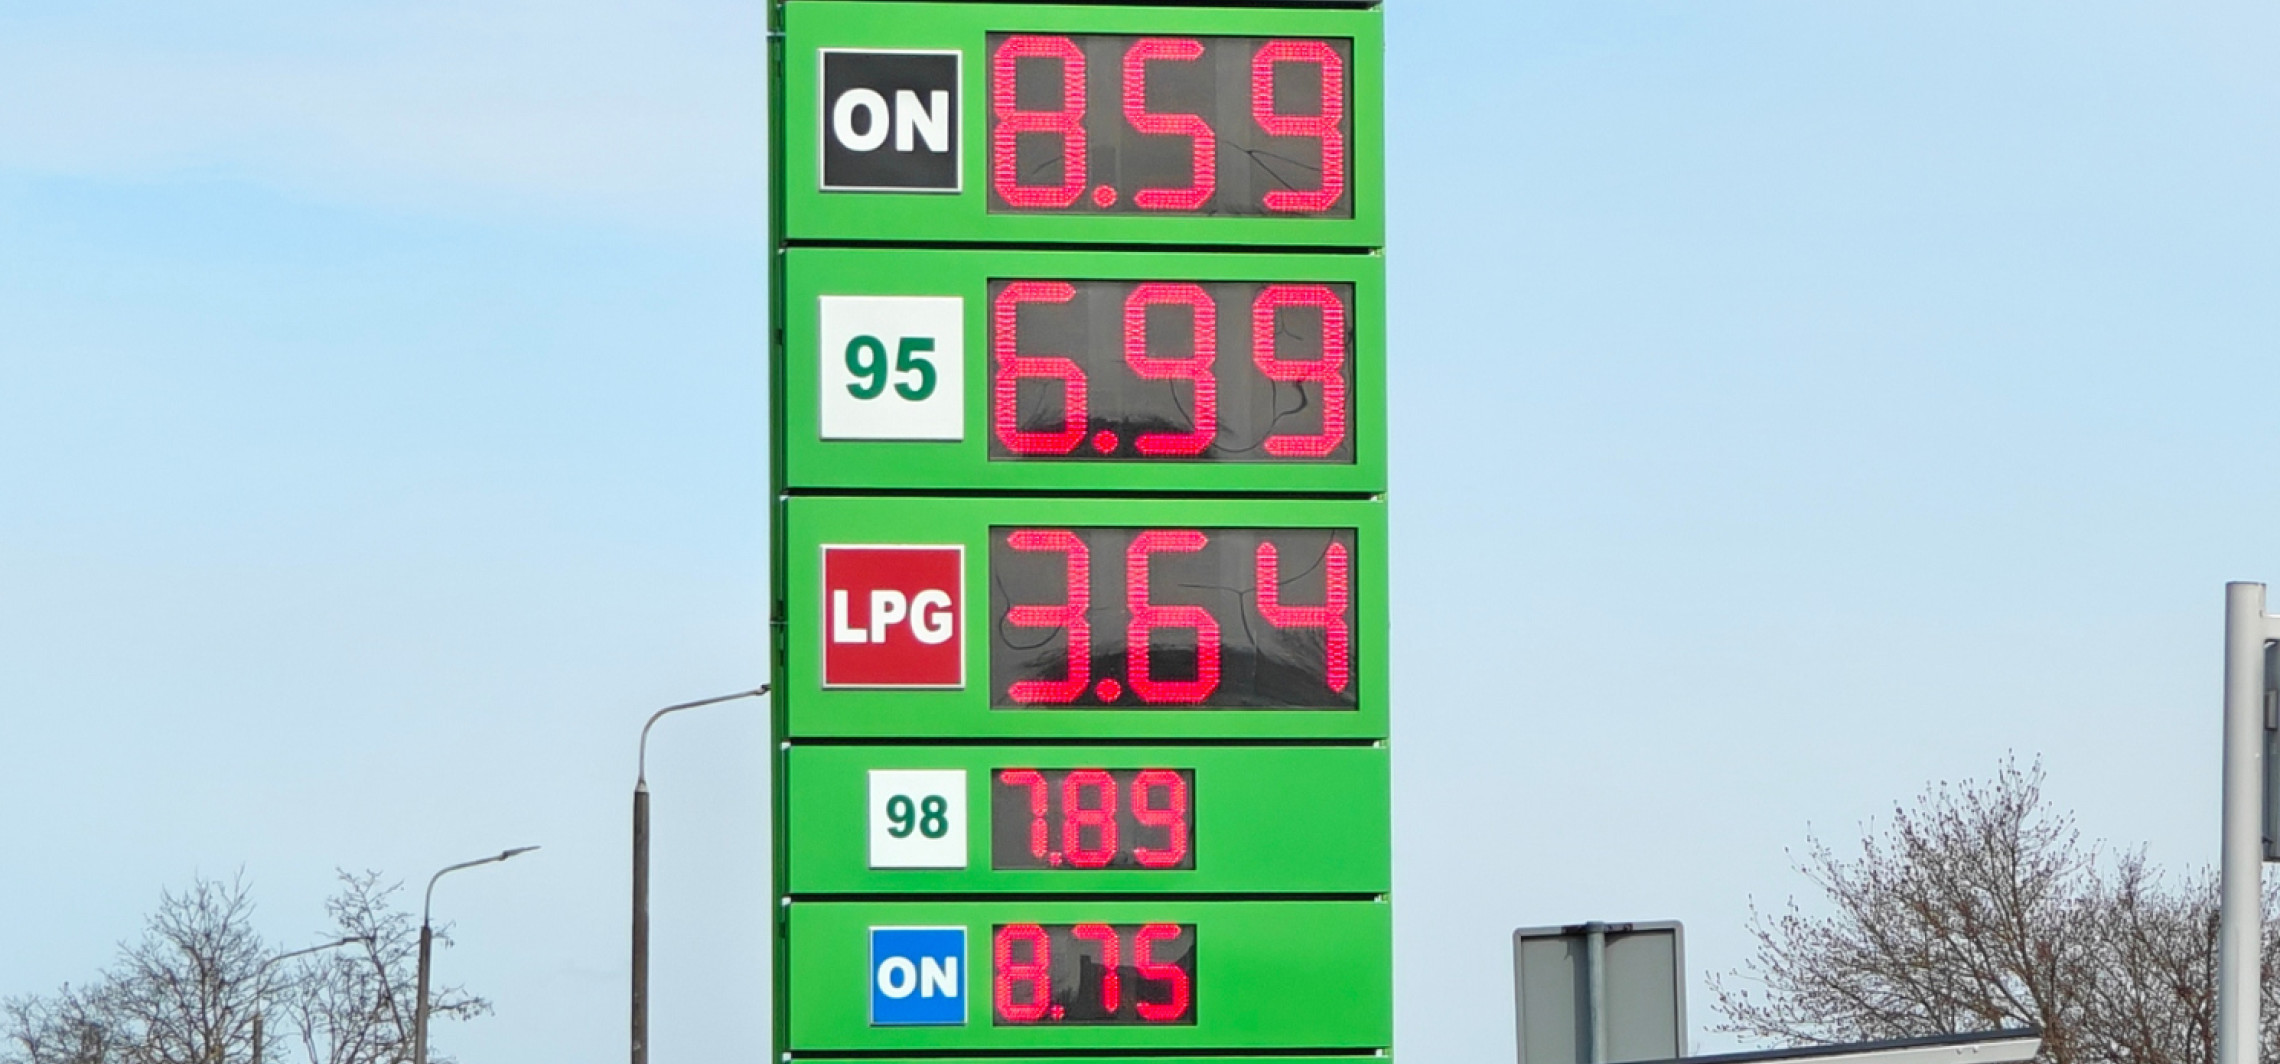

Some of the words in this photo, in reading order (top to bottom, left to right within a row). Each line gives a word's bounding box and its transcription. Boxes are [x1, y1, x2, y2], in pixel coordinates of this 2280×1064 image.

[833, 88, 949, 152] ON
[993, 35, 1344, 211] 8.59
[845, 335, 938, 401] 95
[994, 281, 1346, 457] 6.99
[832, 589, 954, 644] LPG
[1006, 529, 1349, 704] 3.64
[885, 794, 950, 839] 98
[1000, 768, 1187, 868] 7.89
[876, 956, 958, 998] ON
[994, 922, 1190, 1021] 8.75
